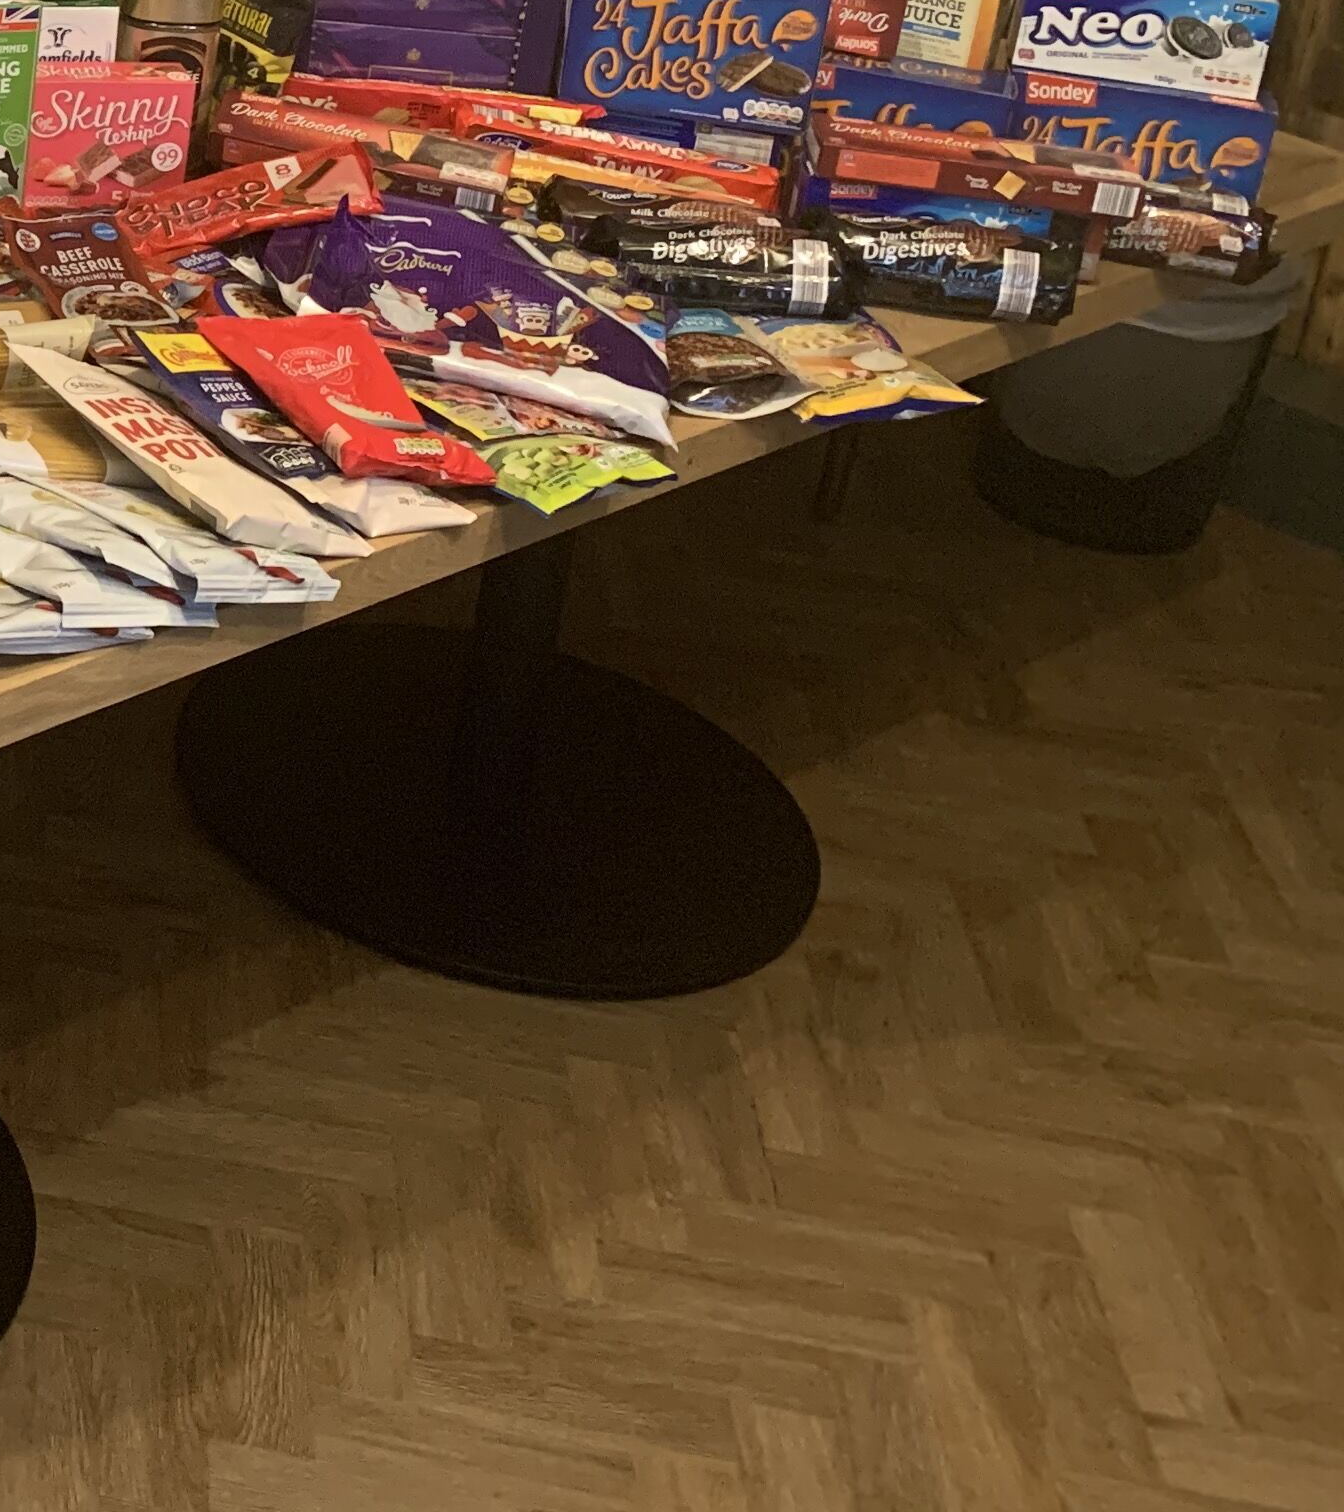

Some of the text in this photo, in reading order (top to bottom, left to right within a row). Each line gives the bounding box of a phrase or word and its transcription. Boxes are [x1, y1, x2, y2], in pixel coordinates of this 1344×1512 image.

[1036, 4, 1165, 46] Neo
[583, 48, 714, 99] Cakes
[30, 88, 189, 138] Skinny
[829, 121, 982, 150] Dark Chocolate
[155, 150, 179, 166] 99
[56, 247, 93, 264] BEEF
[375, 247, 454, 275] Cadbury
[862, 240, 968, 263] Digestives
[39, 257, 125, 278] CASSEROLE
[199, 381, 247, 396] PEPPER
[211, 389, 253, 404] SAUCE
